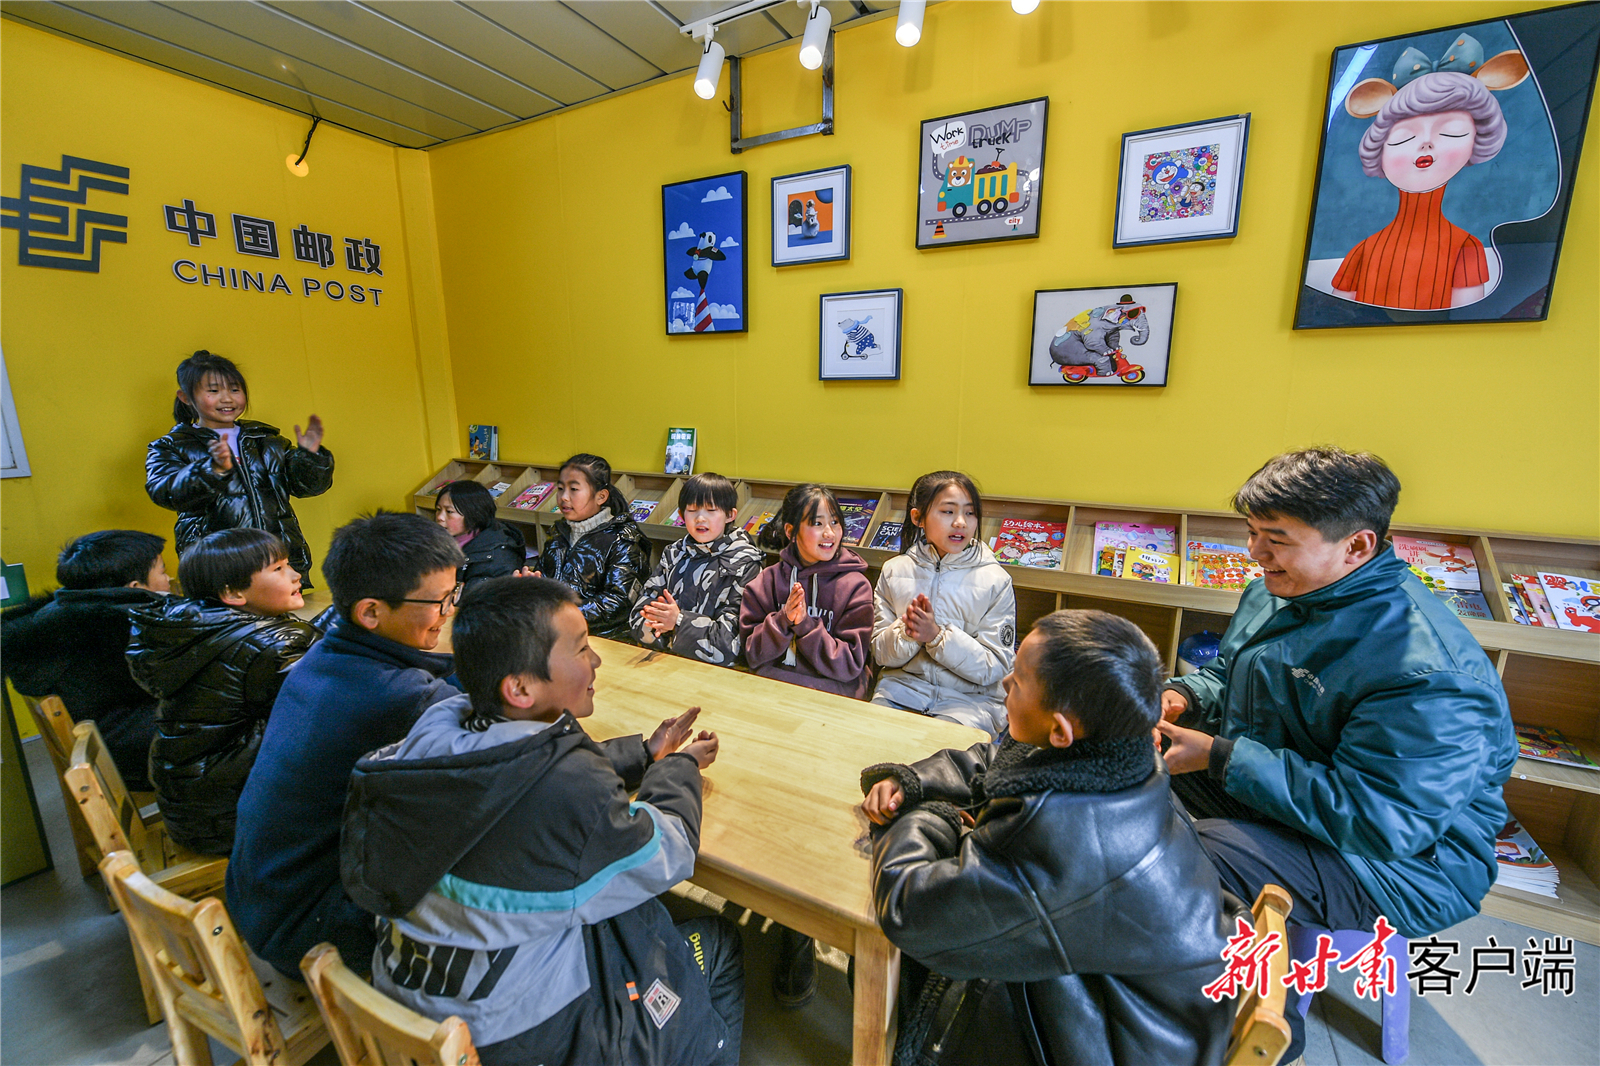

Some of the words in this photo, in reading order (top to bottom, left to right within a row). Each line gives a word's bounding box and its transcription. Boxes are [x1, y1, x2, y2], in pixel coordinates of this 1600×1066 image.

[930, 123, 964, 144] Work
[968, 118, 1032, 146] DUMP
[972, 132, 1012, 148] truck
[940, 139, 959, 150] time
[163, 199, 384, 277] 中国邮政
[172, 259, 292, 295] CHINA
[302, 277, 383, 306] POST
